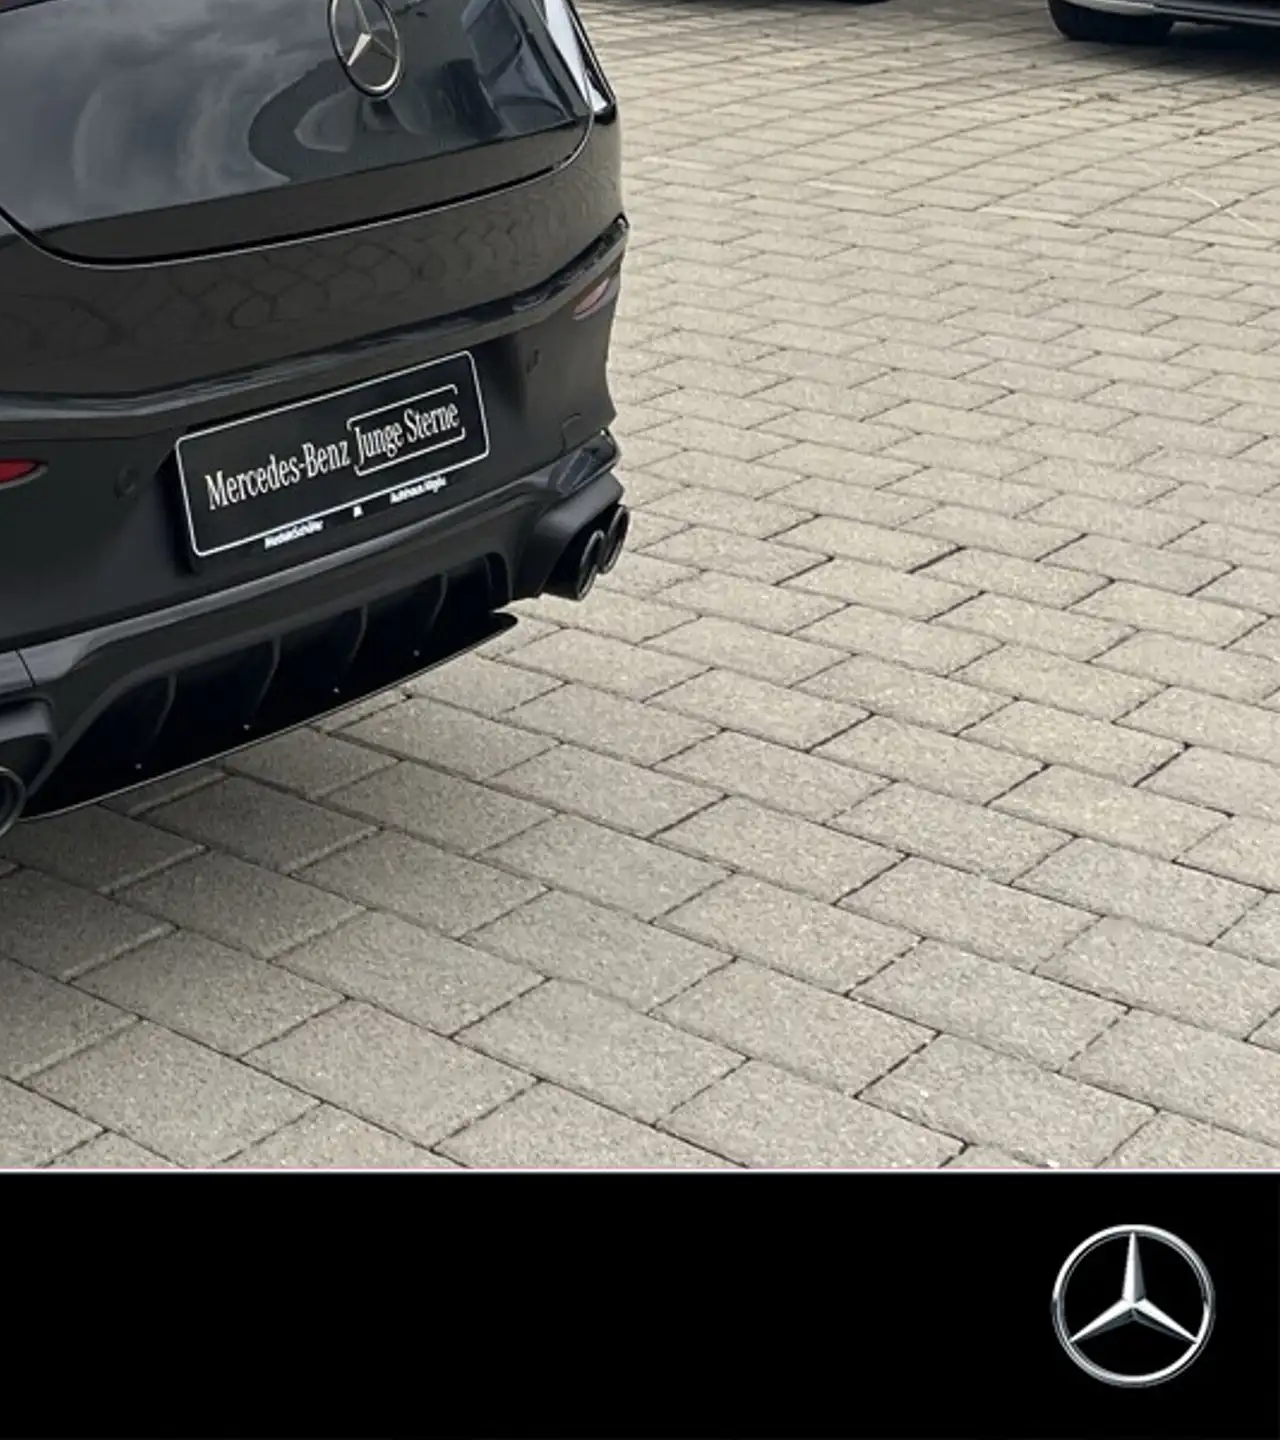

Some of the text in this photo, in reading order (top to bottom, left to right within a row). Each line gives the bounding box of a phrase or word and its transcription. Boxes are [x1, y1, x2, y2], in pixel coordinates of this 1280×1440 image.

[205, 402, 460, 510] Mercedes-Benz Junge Sterne
